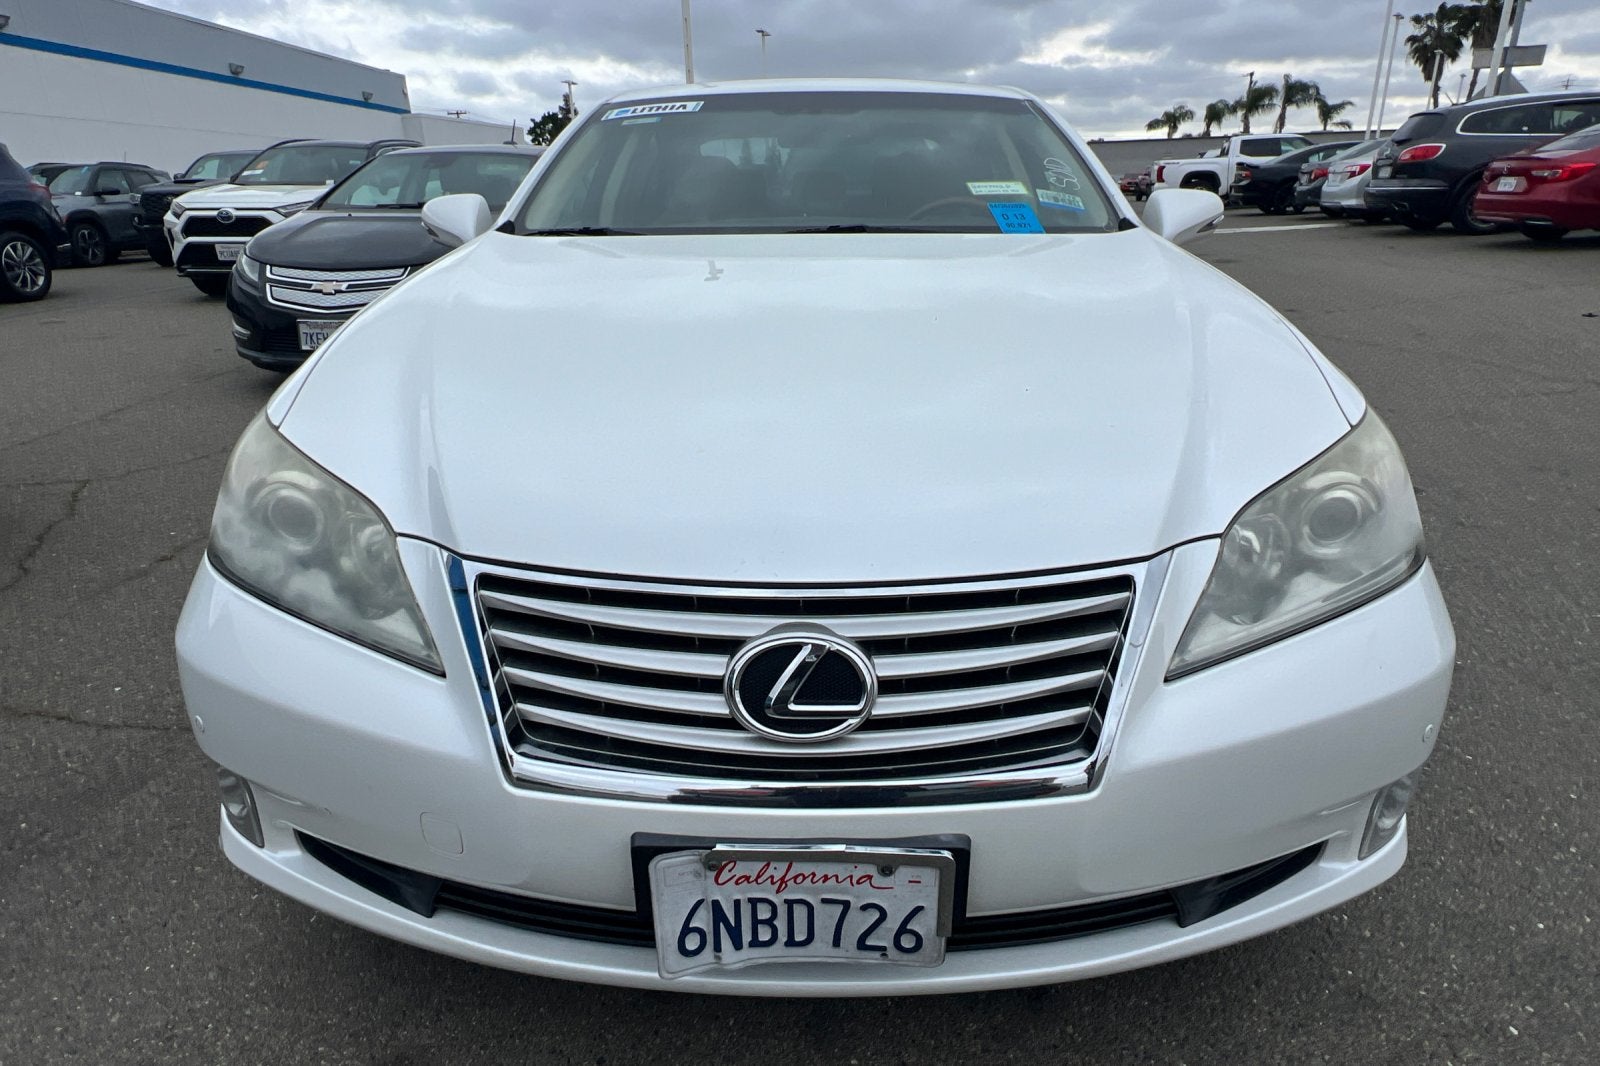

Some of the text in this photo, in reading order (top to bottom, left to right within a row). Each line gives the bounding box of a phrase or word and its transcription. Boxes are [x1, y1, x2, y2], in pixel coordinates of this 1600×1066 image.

[630, 104, 687, 114] LITHIA
[713, 860, 894, 894] California
[677, 897, 925, 958] 6NBD726
